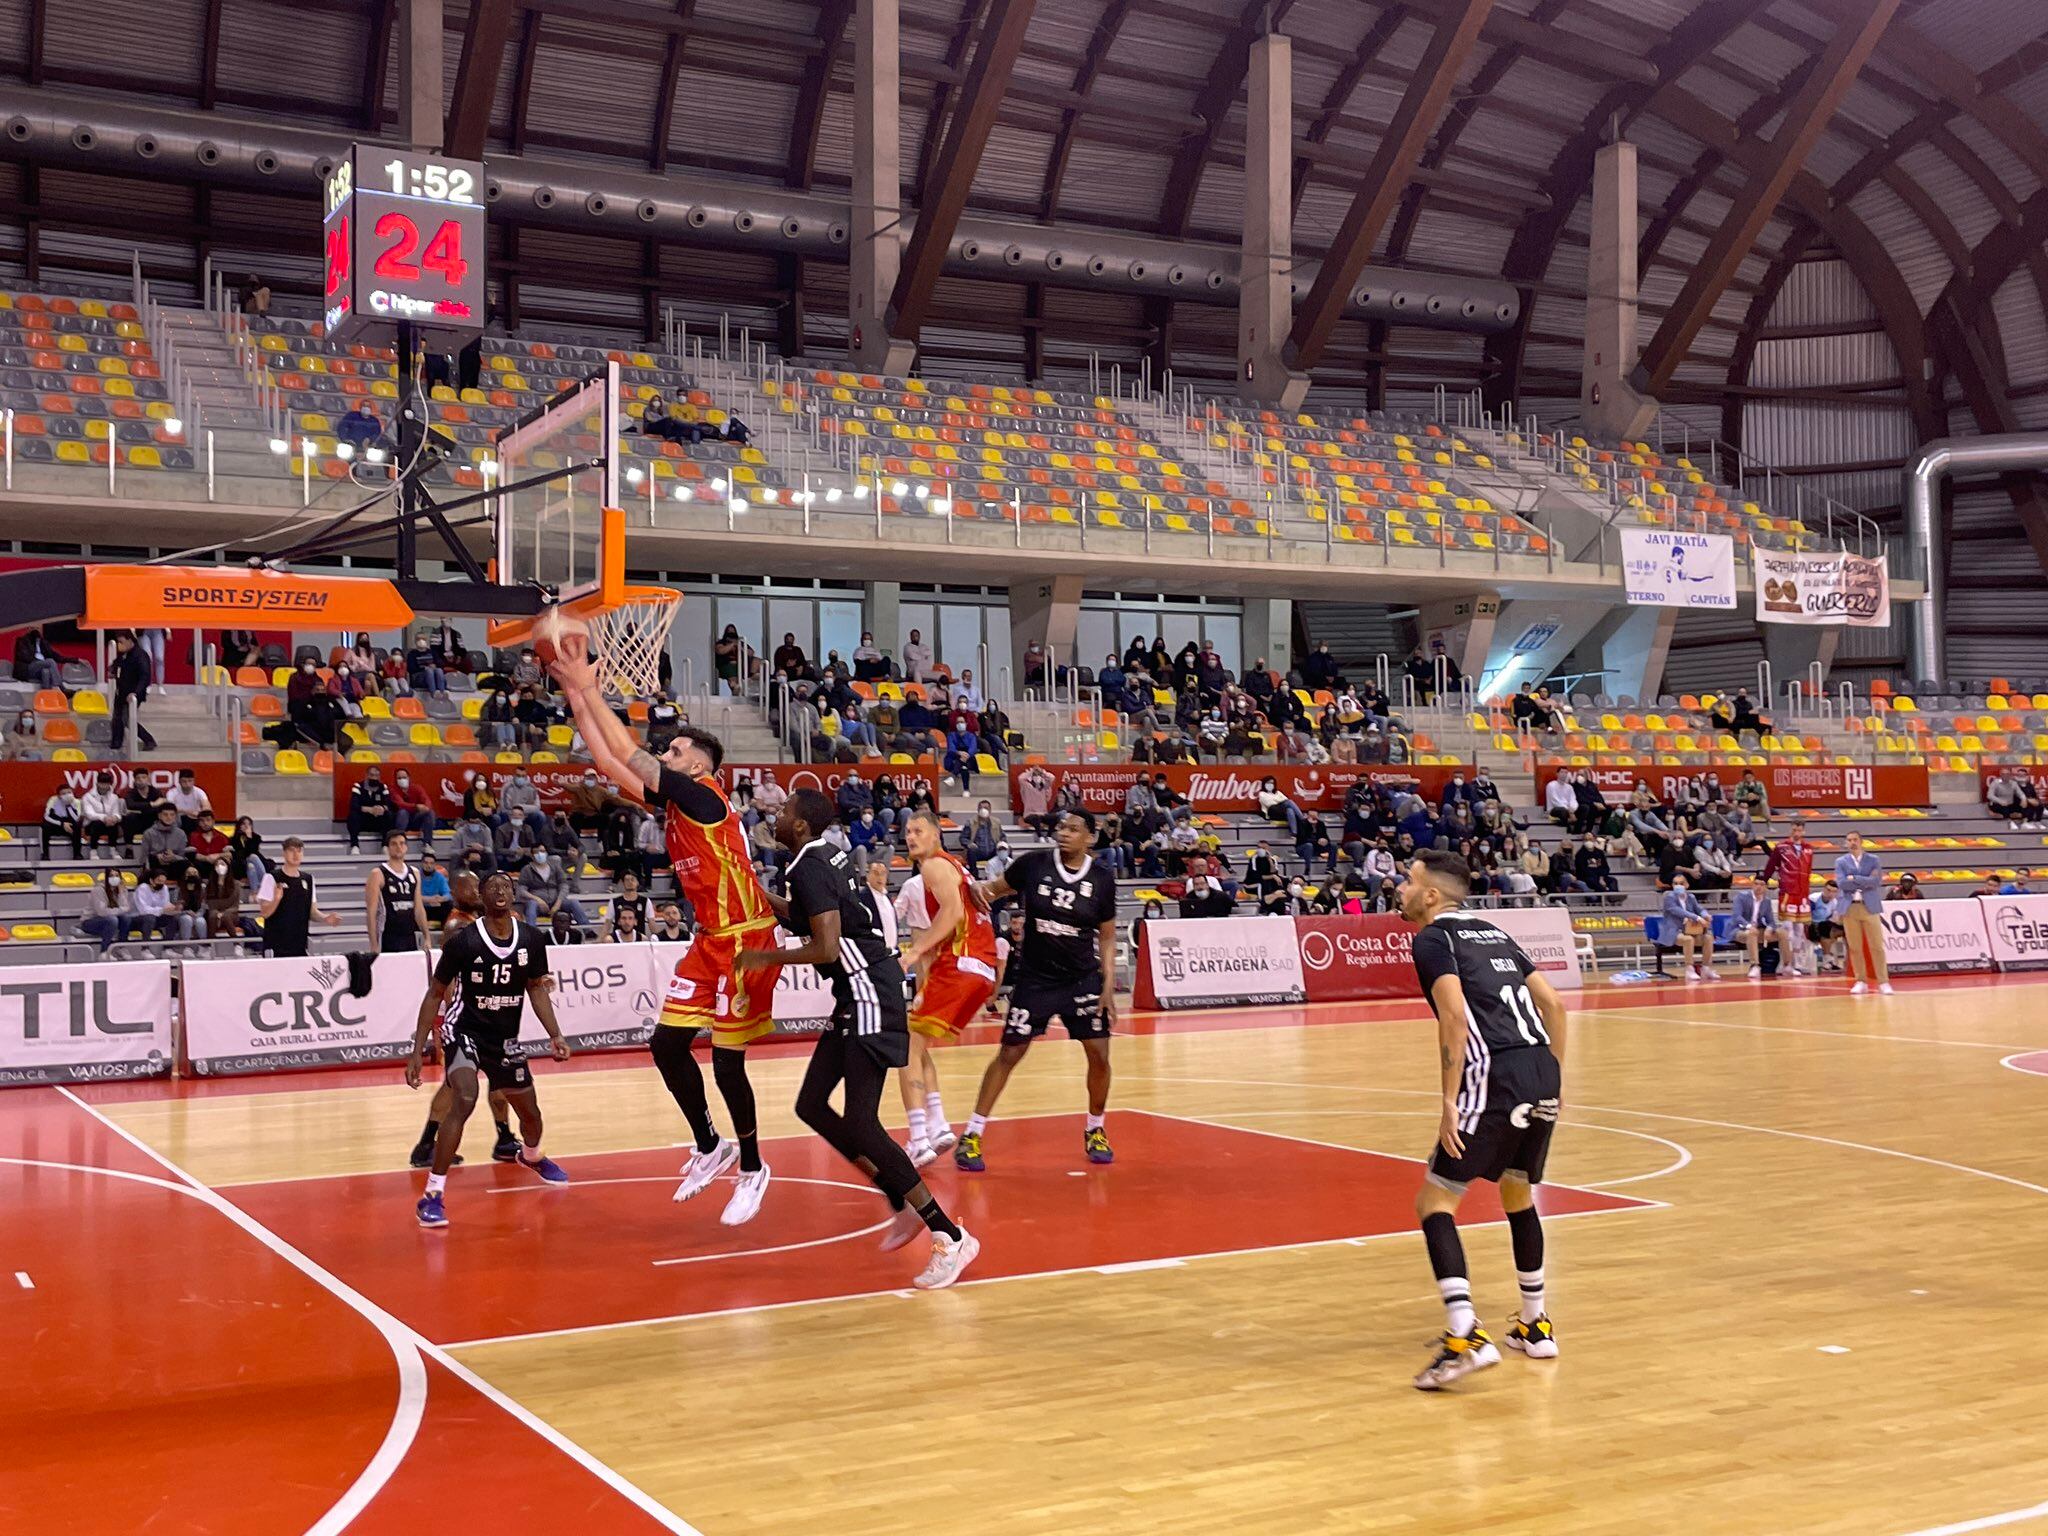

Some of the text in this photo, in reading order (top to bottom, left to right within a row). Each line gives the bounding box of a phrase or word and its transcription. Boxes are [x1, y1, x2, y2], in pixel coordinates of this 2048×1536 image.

[385, 160, 473, 203] 1:52
[375, 212, 468, 287] 24
[1645, 534, 1671, 545] JAVI
[1626, 591, 1665, 602] ETERNO
[1792, 789, 1821, 798] HOTEL
[1052, 888, 1076, 910] 32
[1336, 934, 1383, 951] Costa
[1235, 945, 1268, 959] CLUB
[1346, 952, 1383, 968] Región
[1385, 951, 1398, 964] de
[492, 964, 512, 984] 15
[1189, 958, 1294, 973] CARTAGENA SAD
[551, 992, 617, 1009] NLINE
[250, 987, 367, 1033] CRC
[1500, 984, 1550, 1045] 11
[280, 1033, 316, 1046] RURAL
[318, 1030, 368, 1042] CENTRAL
[236, 1054, 300, 1070] CARTAGENA
[69, 1064, 128, 1081] VAMOS!
